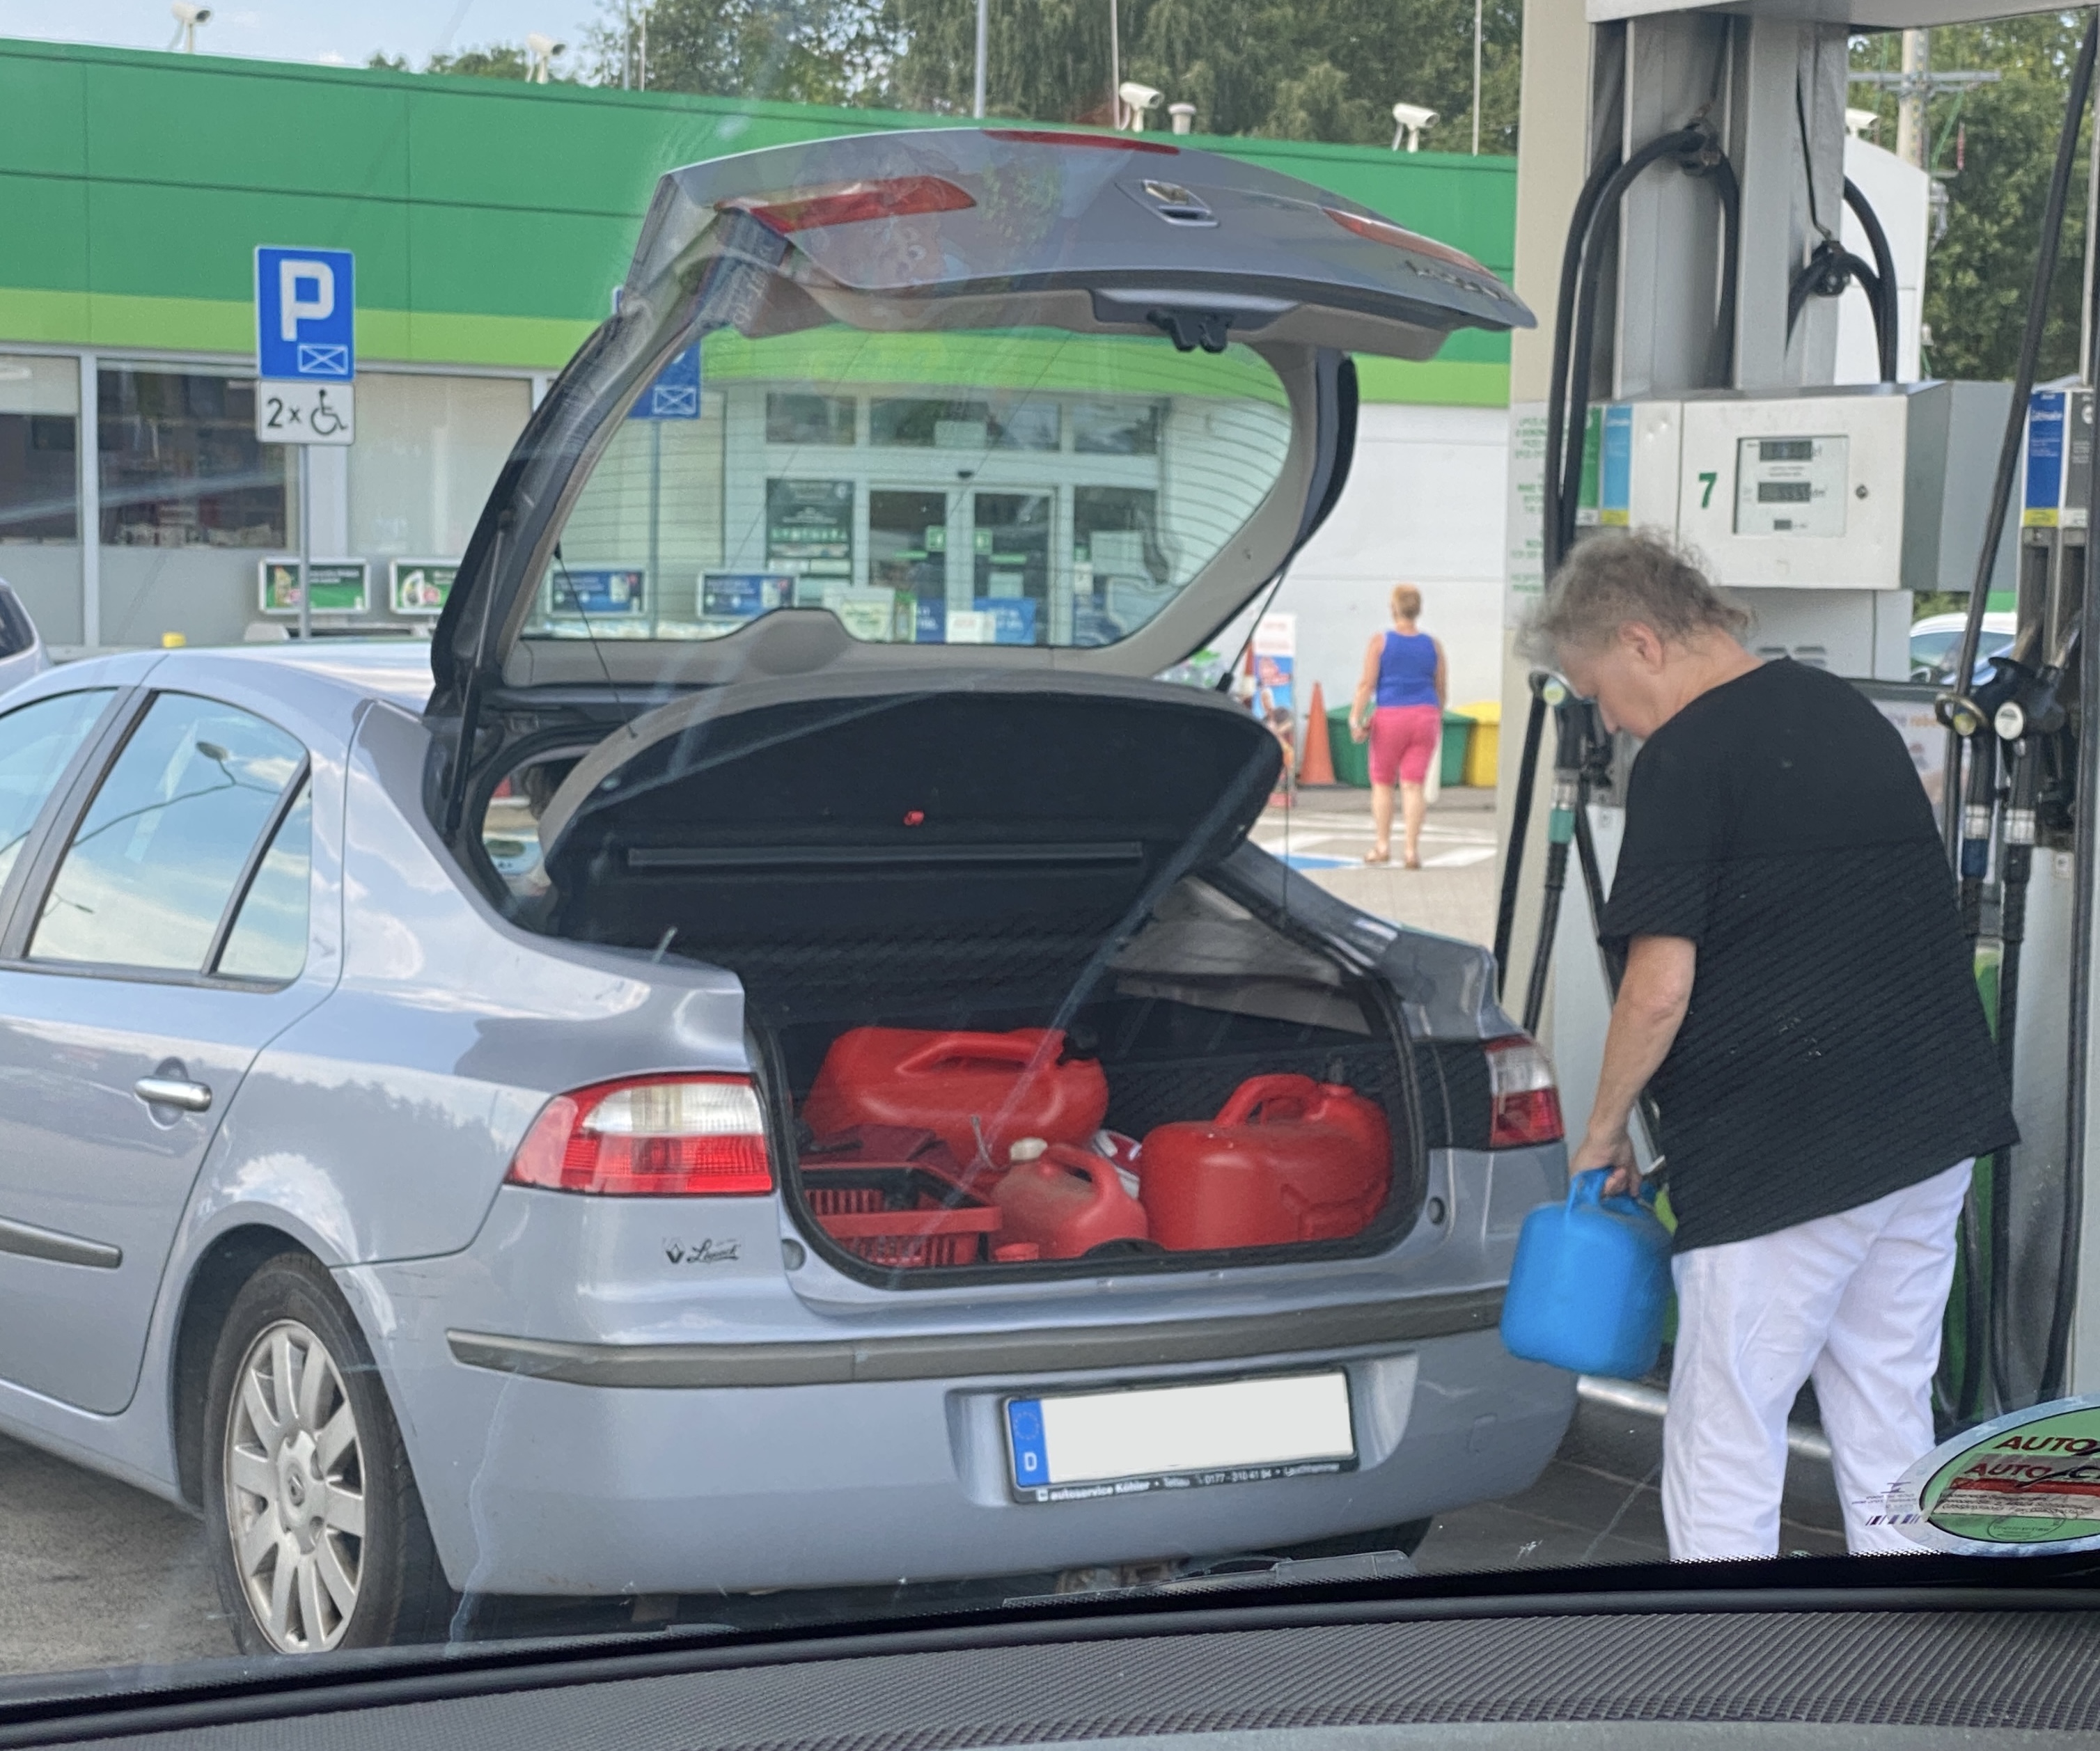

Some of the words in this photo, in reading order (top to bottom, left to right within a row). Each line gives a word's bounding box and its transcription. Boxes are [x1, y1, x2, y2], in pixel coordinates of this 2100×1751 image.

[279, 260, 335, 342] P
[1699, 472, 1717, 509] 7
[1993, 1435, 2099, 1453] AUTO
[1024, 1452, 1038, 1473] D
[1964, 1462, 2053, 1479] AUTO
